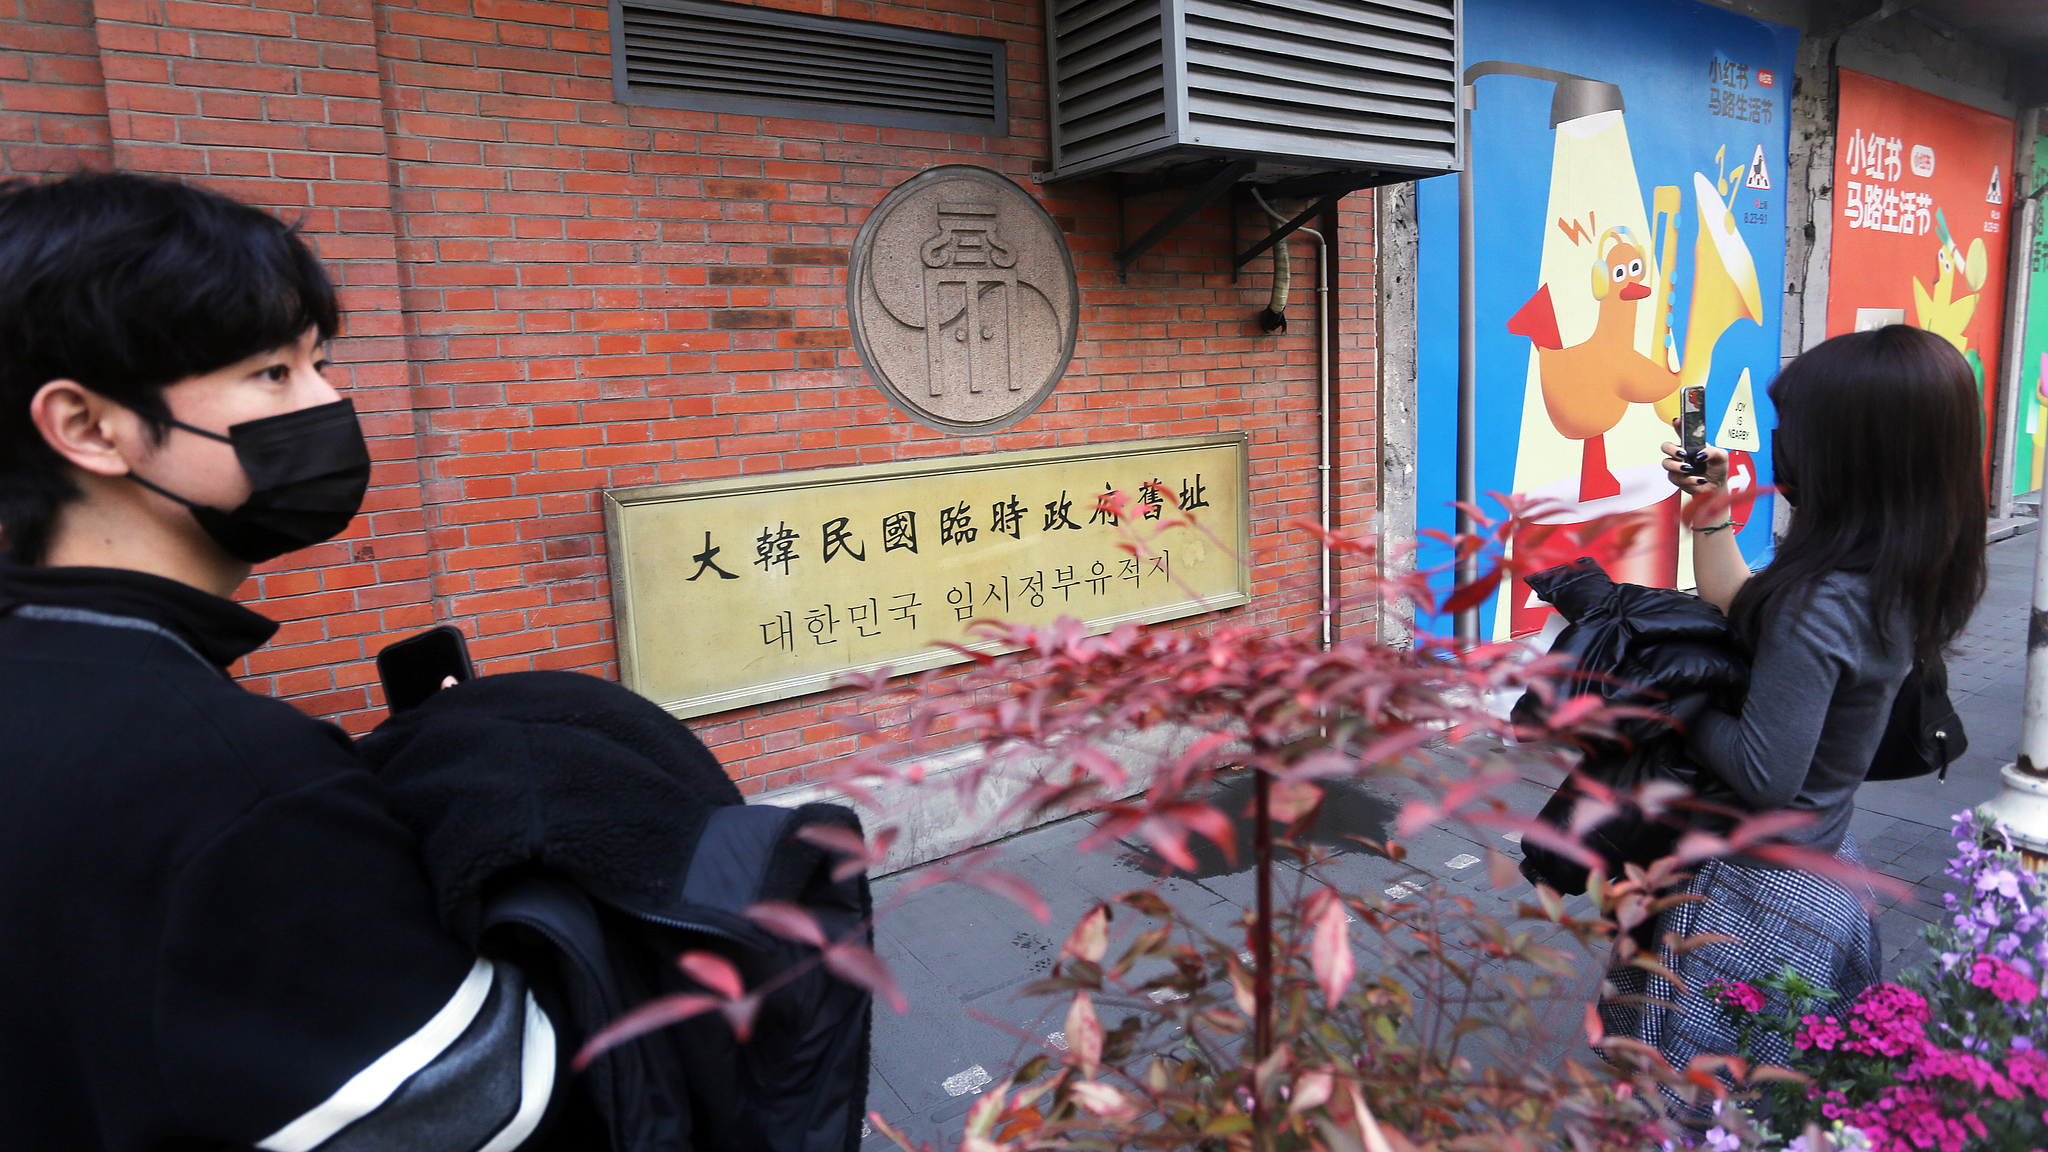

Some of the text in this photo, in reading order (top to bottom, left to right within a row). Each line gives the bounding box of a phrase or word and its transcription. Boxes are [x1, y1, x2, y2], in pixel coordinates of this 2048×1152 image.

[1709, 56, 1749, 90] 小红书
[1708, 87, 1773, 125] 马路生活节
[1846, 128, 1903, 182] 小红书
[1844, 181, 1933, 236] 马路生活节
[1734, 402, 1747, 412] JOY
[1737, 416, 1743, 426] IS
[1728, 428, 1750, 440] NEARBY
[760, 549, 1169, 653] 대한민국 임시정부유적지
